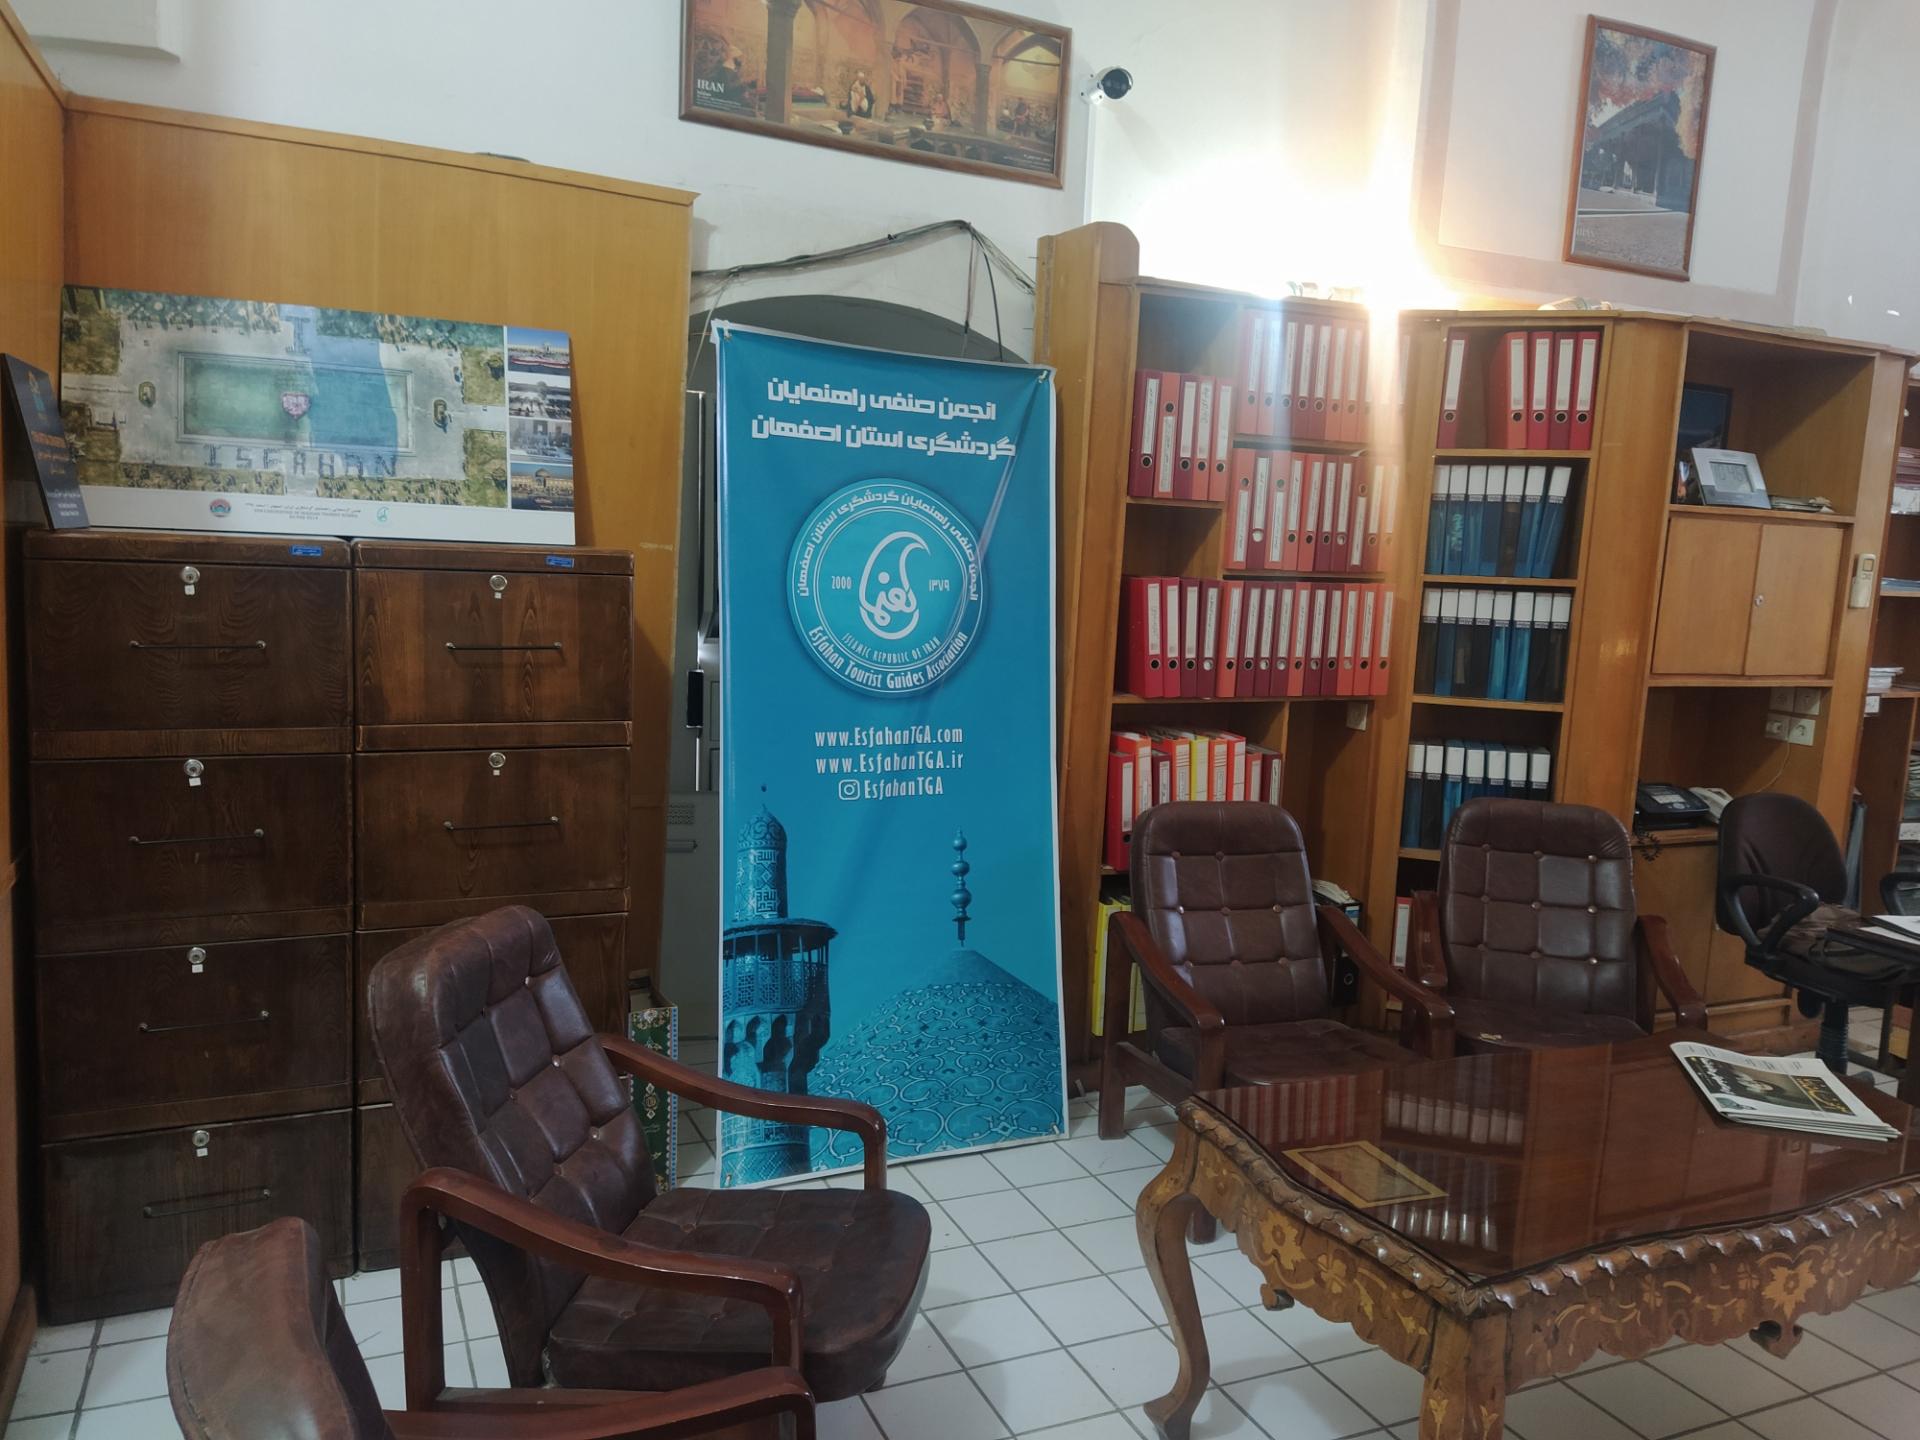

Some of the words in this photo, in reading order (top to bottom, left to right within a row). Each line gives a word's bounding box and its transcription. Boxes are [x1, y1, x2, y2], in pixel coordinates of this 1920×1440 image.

[697, 79, 725, 93] IRAN
[767, 377, 866, 412] راهنمایان
[869, 392, 936, 414] صنفی
[938, 397, 997, 423] انجمن
[752, 414, 842, 443] اصفهان
[845, 424, 904, 448] استان
[907, 431, 1017, 460] گردشگری
[837, 489, 900, 516] گردشگری
[901, 493, 950, 530] راهنمایان
[812, 511, 838, 545] استان
[949, 526, 976, 563] صنفی
[797, 542, 816, 597] اصفهان
[831, 576, 852, 590] 2000
[928, 579, 950, 592] ۱۳۷۹
[809, 625, 845, 670] Esfahan
[844, 661, 883, 688] Tourist
[886, 671, 925, 689] Guides
[926, 631, 969, 681] Association
[873, 652, 909, 664] REPUBLIC
[911, 646, 922, 660] OF
[923, 636, 942, 654] IRAN
[815, 725, 963, 748] www.EsfahanTGA.com
[816, 750, 964, 774] www.EsfahanTGA.ir
[864, 776, 944, 800] EsfahanTGA
